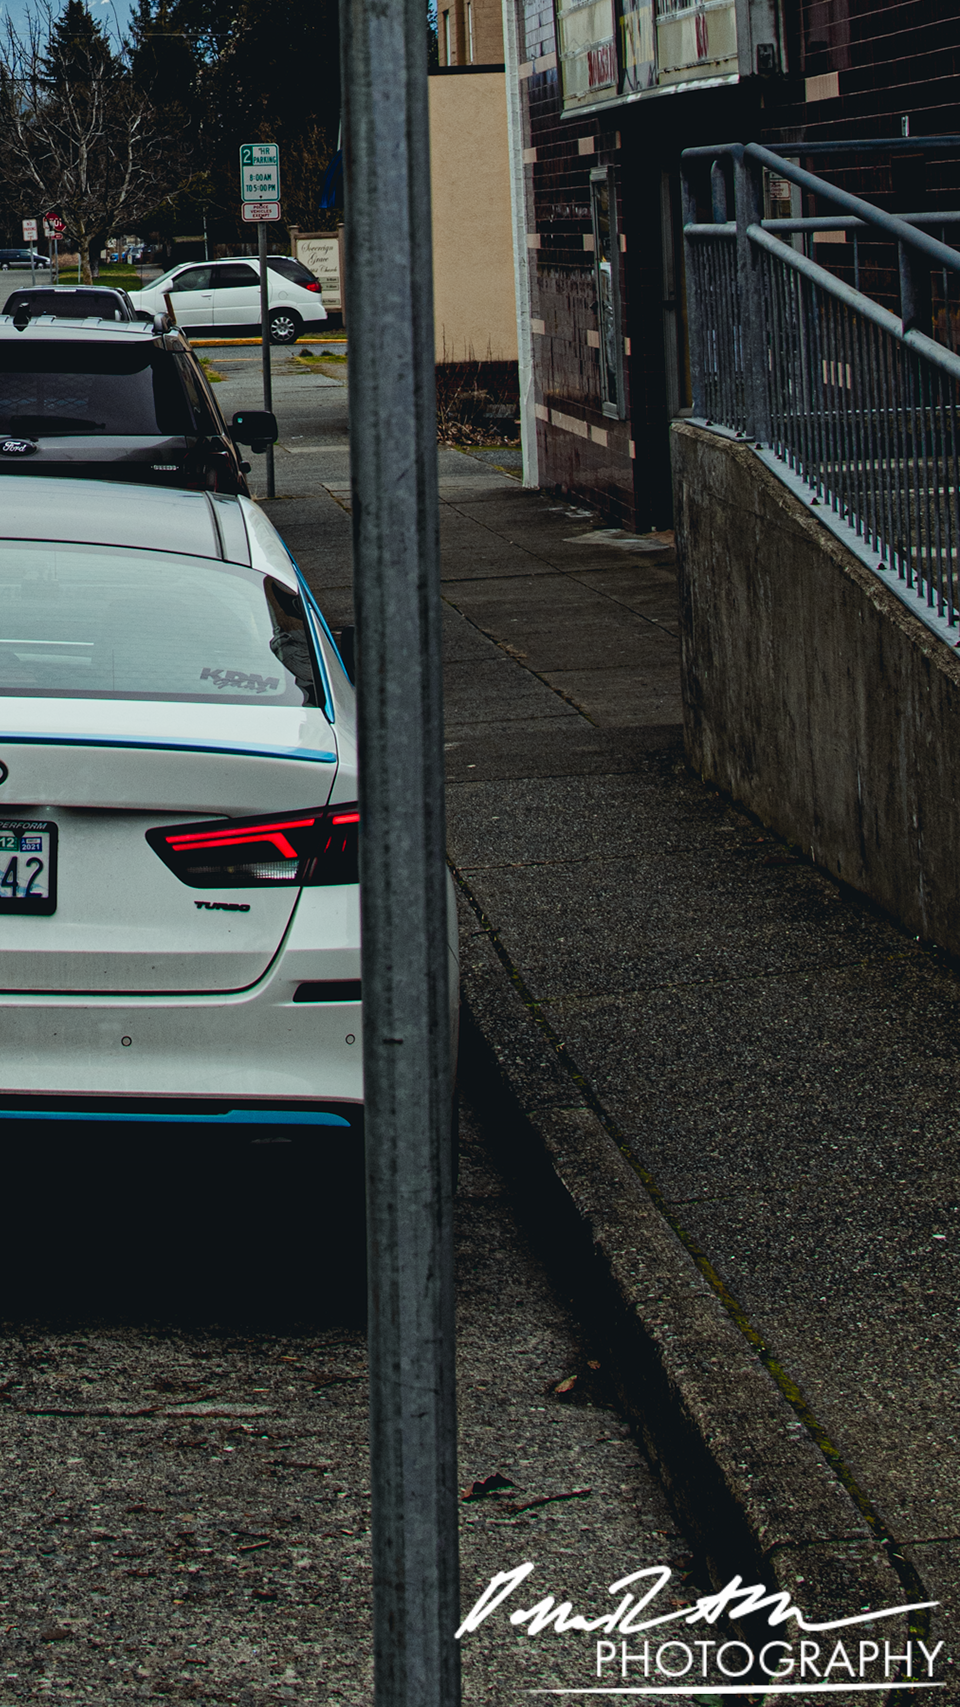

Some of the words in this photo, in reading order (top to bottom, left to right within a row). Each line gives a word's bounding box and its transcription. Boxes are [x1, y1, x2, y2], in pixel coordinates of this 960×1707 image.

[243, 149, 251, 163] 2
[260, 147, 270, 155] HR
[253, 156, 277, 164] PARKING
[2, 441, 27, 453] Ford
[200, 667, 280, 691] KDM
[21, 843, 41, 851] 2021
[193, 900, 251, 912] TURBO
